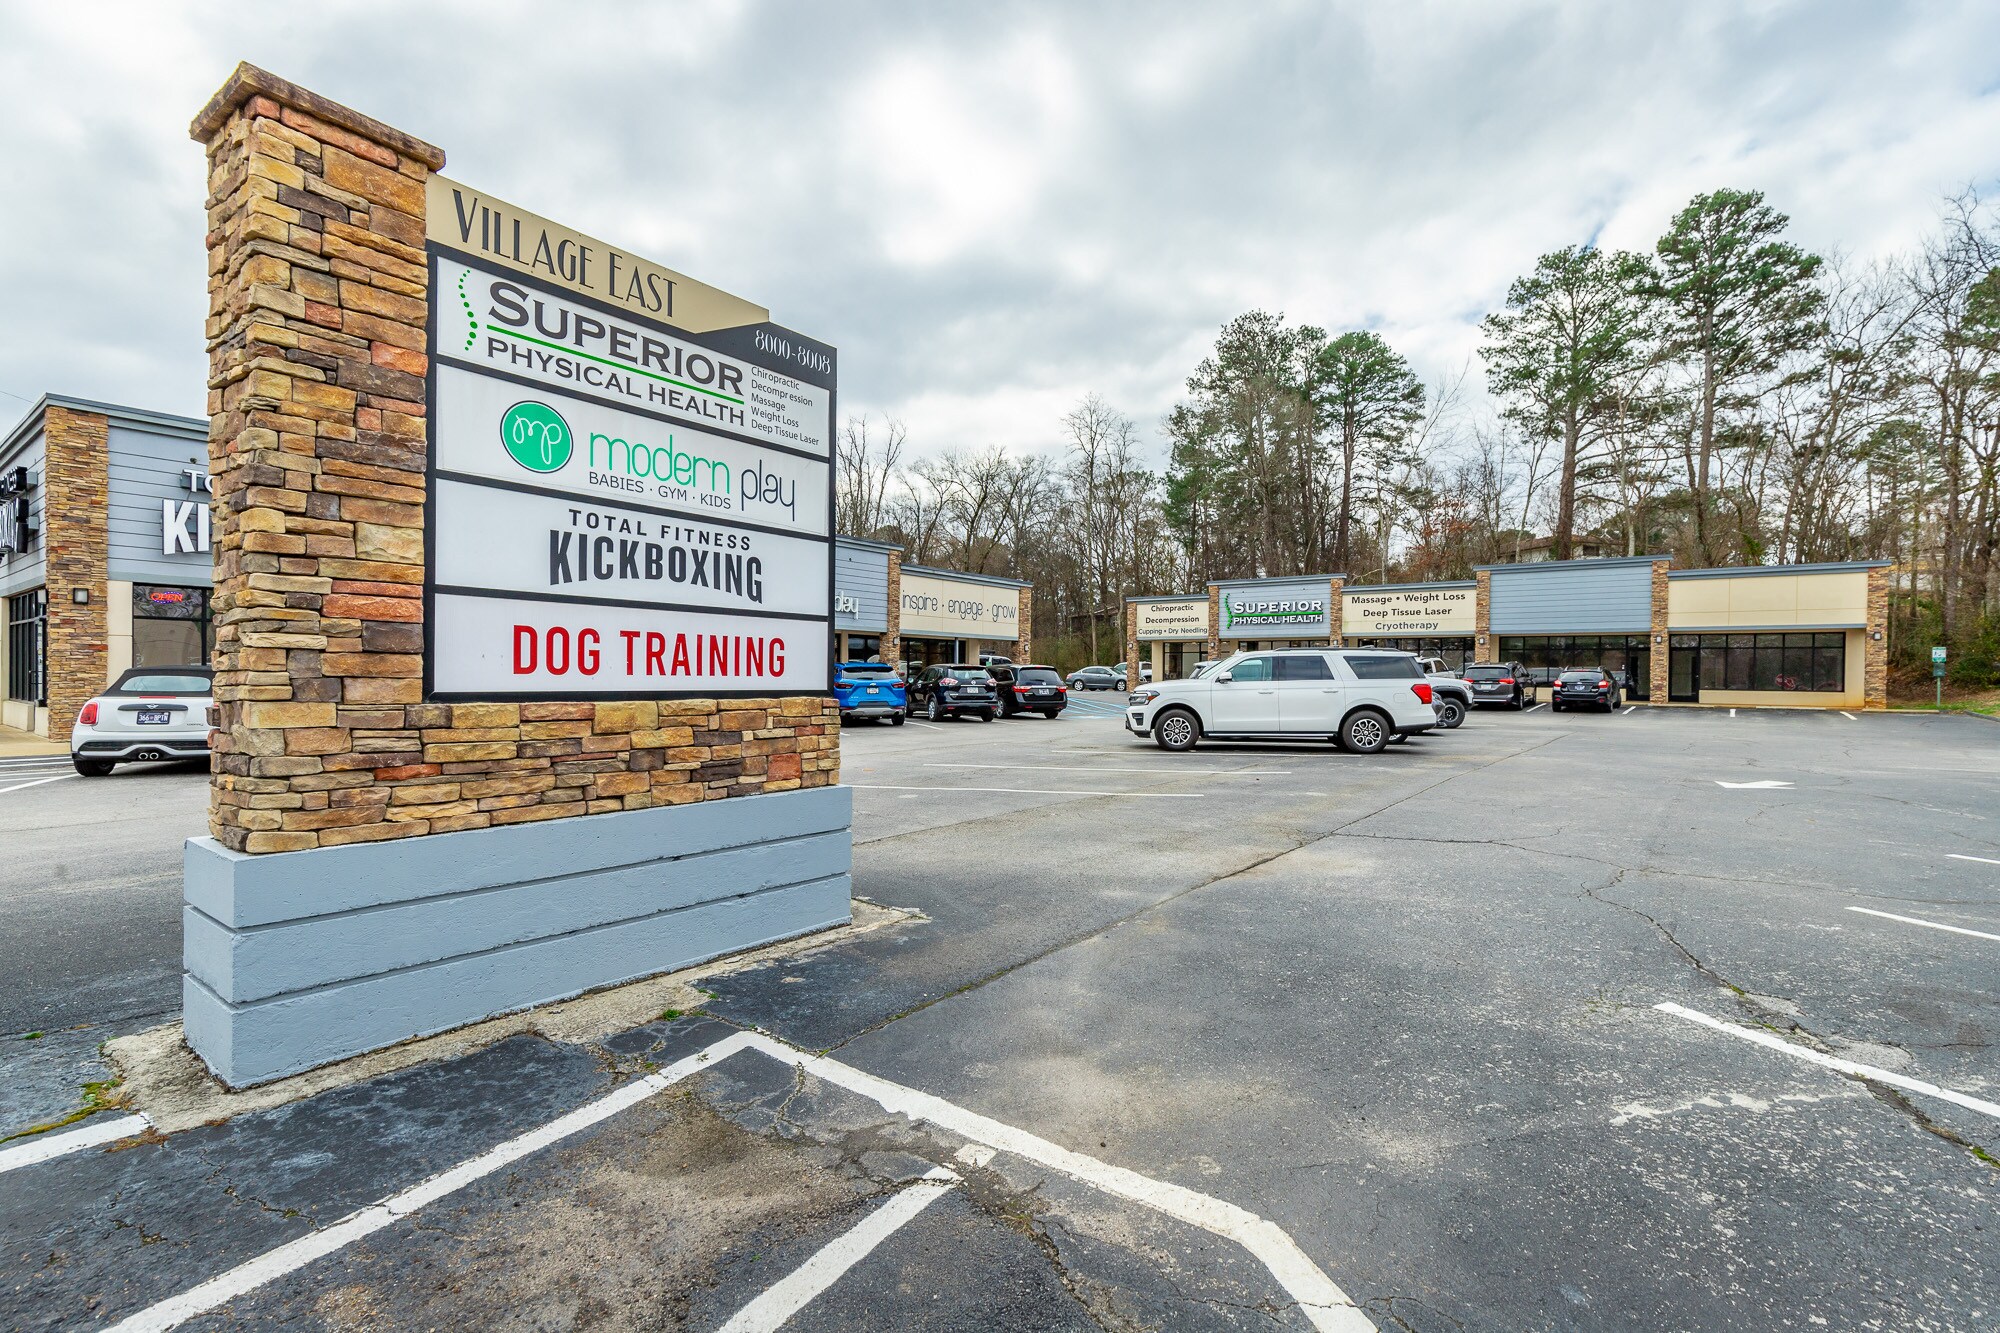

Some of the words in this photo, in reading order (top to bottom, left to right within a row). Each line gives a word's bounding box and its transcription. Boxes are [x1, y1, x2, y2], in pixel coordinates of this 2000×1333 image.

[452, 188, 594, 289] VILLAGE
[609, 252, 677, 318] EAST
[488, 281, 744, 396] SUPERIOR
[755, 329, 831, 374] 8000-8008
[487, 336, 642, 399] PHYSICAL
[648, 383, 744, 426] HEALTH
[751, 366, 800, 390] Chiropractic
[751, 379, 813, 406] Decompression
[751, 392, 786, 411] Massage
[751, 405, 781, 422] Weight
[782, 415, 799, 428] Loss
[751, 419, 773, 434] Deep
[774, 425, 798, 440] Tissue
[799, 433, 819, 445] Laser
[590, 432, 730, 494] modern
[741, 459, 795, 521] play
[589, 471, 644, 493] BABIES
[658, 485, 687, 501] GYM
[700, 493, 731, 509] KIDS
[568, 508, 647, 536] TOTAL
[660, 524, 751, 551] FITNESS
[549, 529, 763, 604] KICKBOXING
[150, 592, 183, 603] OPEN
[902, 589, 938, 615] inspire
[948, 599, 983, 620] engage
[991, 603, 1016, 622] grow
[1150, 604, 1194, 613] Chiropractic
[1233, 600, 1323, 614] SUPERIOR
[1351, 596, 1393, 605] Massage
[1403, 593, 1440, 603] Weight
[1443, 592, 1466, 601] Loss
[1145, 616, 1200, 624] Decompression
[1233, 616, 1280, 625] PHYSICAL
[1282, 614, 1323, 624] HEALTH
[1363, 609, 1388, 618] Deep
[1391, 608, 1422, 616] Tissue
[1424, 607, 1452, 616] Laser
[1375, 621, 1439, 631] Cryotherapy
[513, 624, 600, 676] DOG
[619, 630, 785, 678] TRAINING
